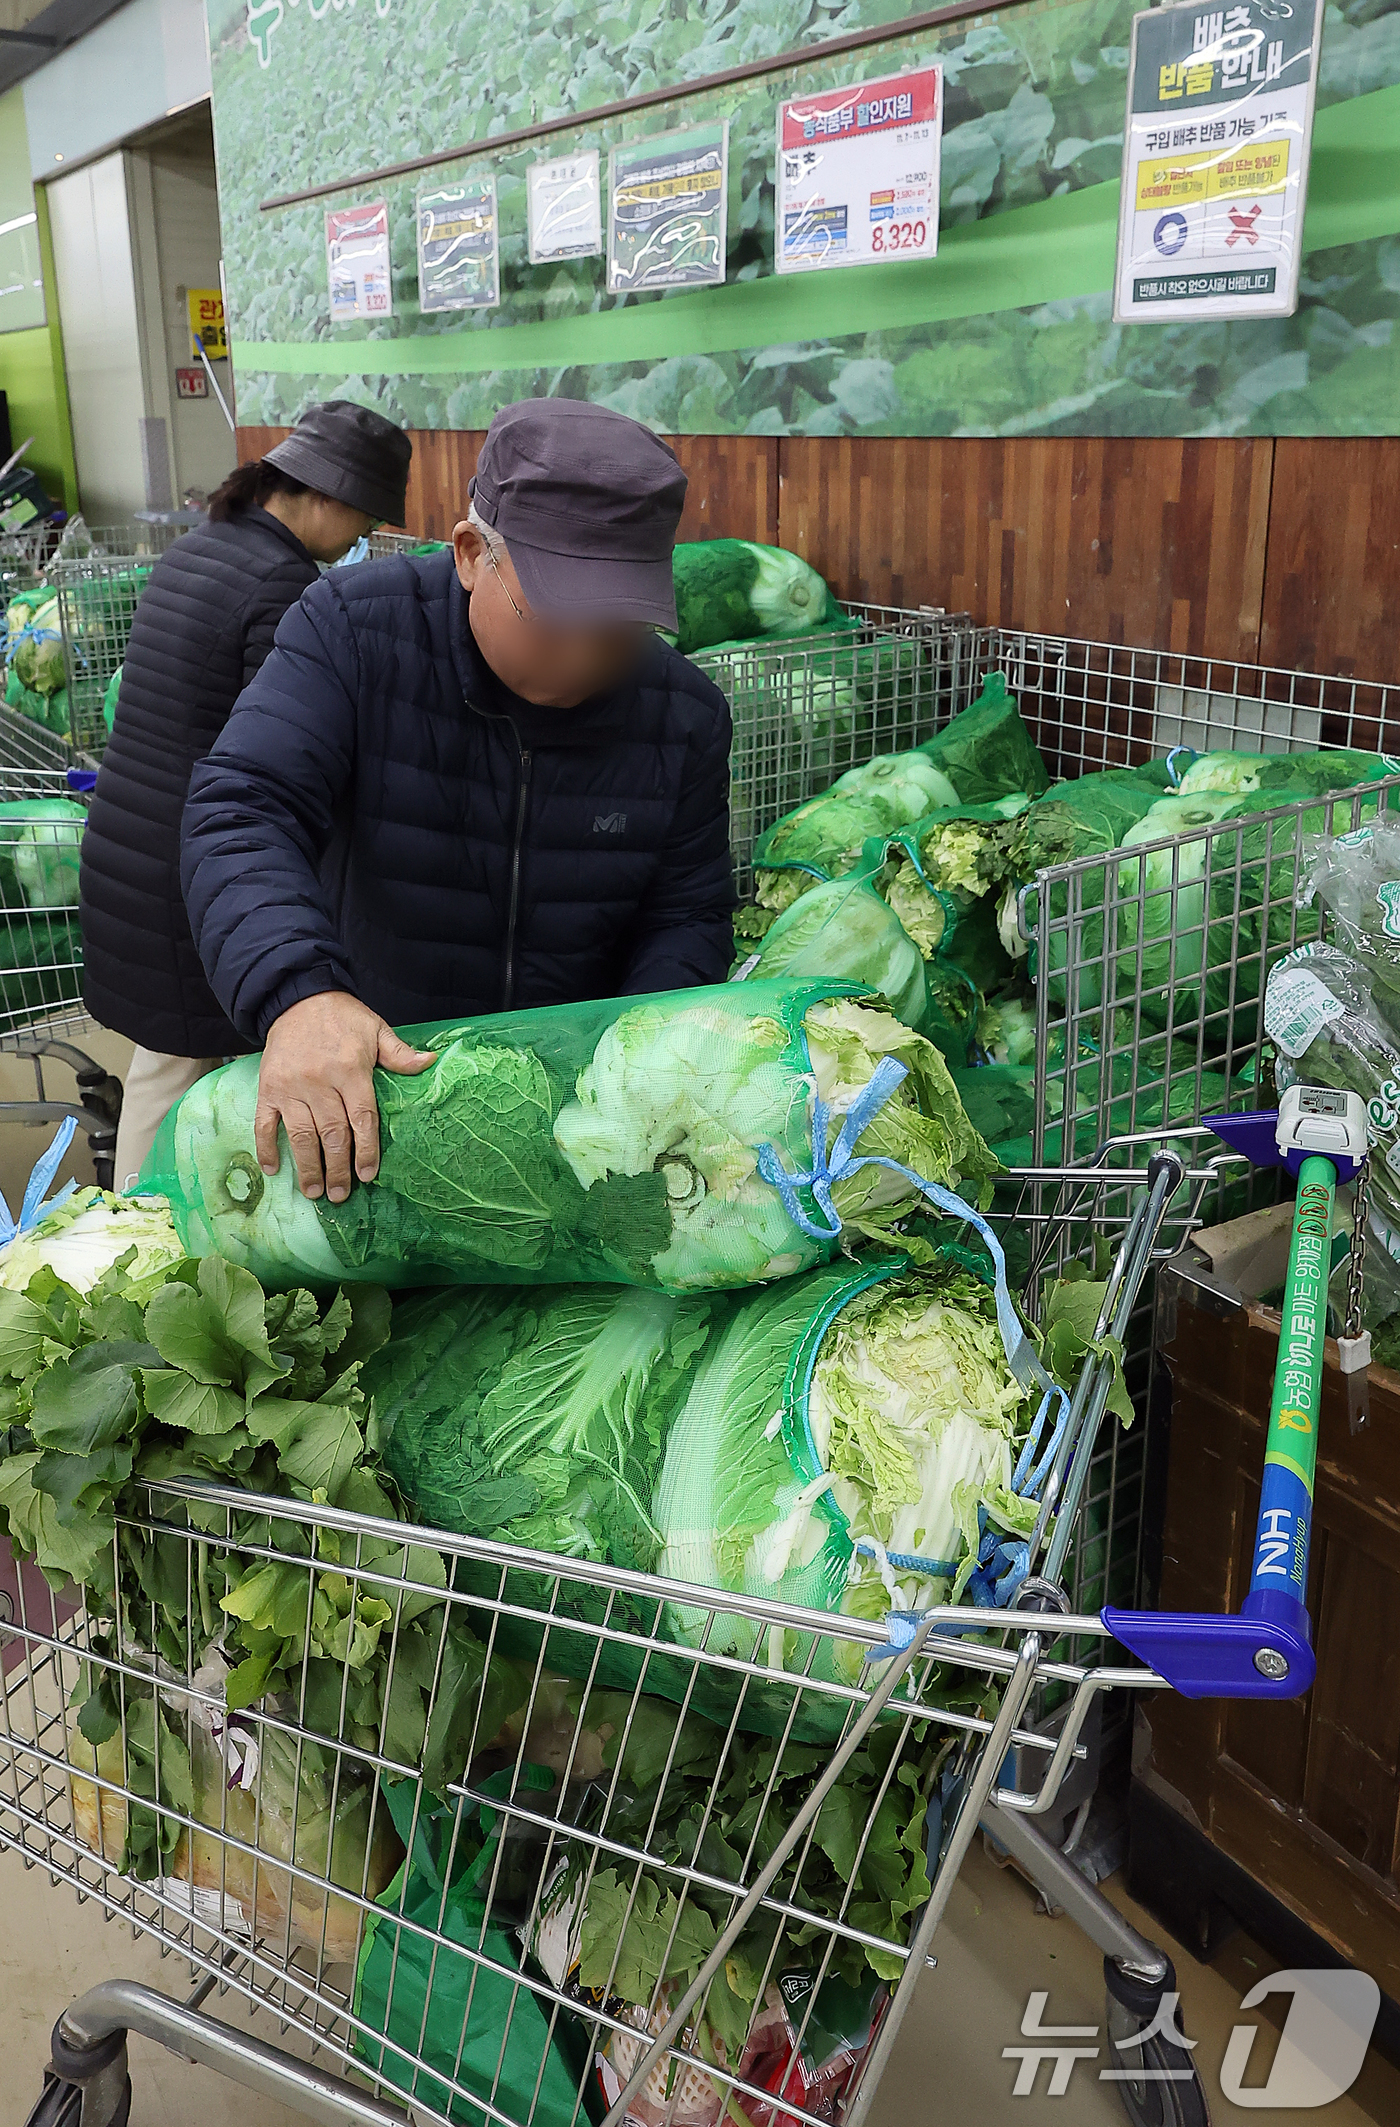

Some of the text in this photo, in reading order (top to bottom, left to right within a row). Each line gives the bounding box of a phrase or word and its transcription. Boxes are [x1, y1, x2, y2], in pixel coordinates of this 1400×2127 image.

[1193, 5, 1251, 52] 배추
[1159, 40, 1283, 101] 반품 안내
[857, 93, 913, 128] 할인지원
[1145, 131, 1170, 151] 구입
[1172, 127, 1197, 147] 배추
[1200, 122, 1226, 143] 반품
[1229, 117, 1256, 138] 가능
[1235, 158, 1253, 173] 또는
[872, 221, 926, 254] 8,320
[1139, 274, 1269, 297] 반품시 착오 없으시길 바랍니다
[1295, 1236, 1323, 1280] 양재점
[1282, 1371, 1311, 1409] 농협
[1256, 1509, 1292, 1576] NH
[1289, 1516, 1308, 1587] NongHyup
